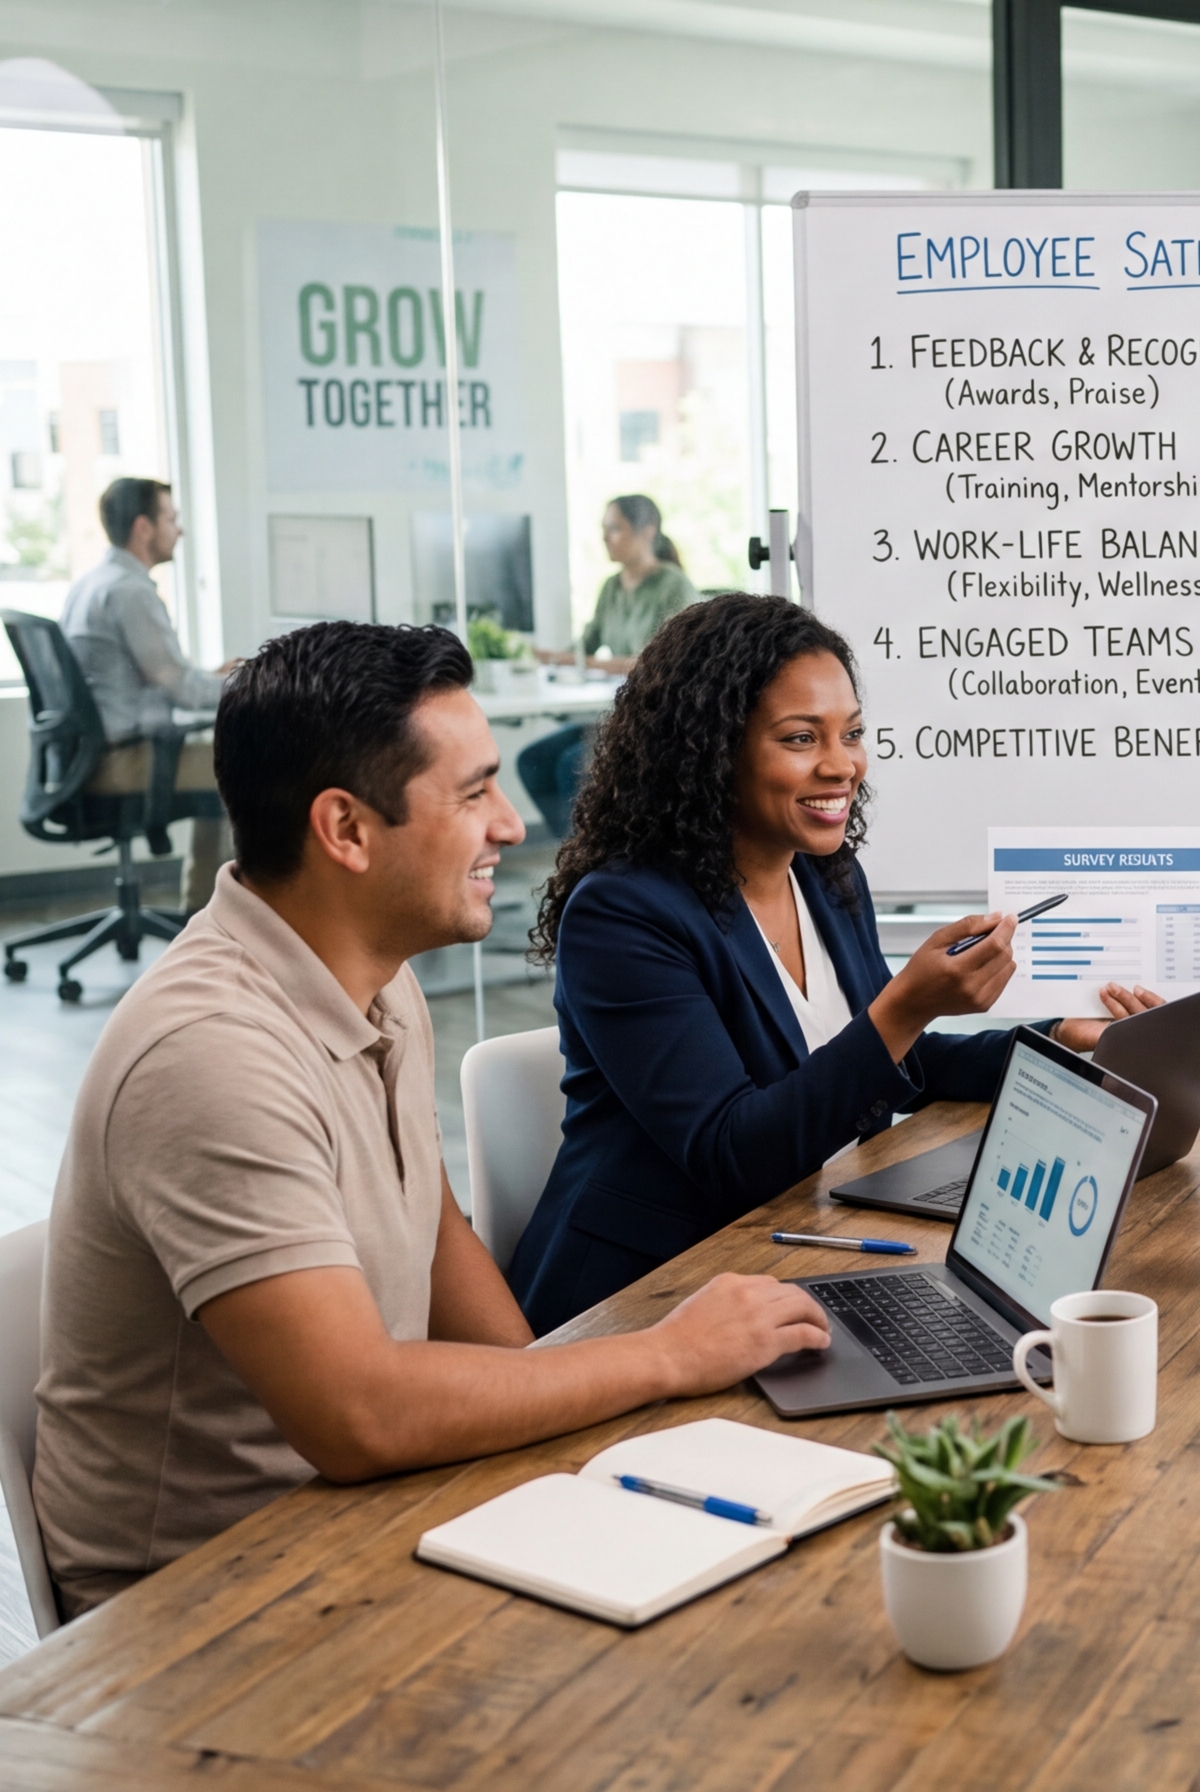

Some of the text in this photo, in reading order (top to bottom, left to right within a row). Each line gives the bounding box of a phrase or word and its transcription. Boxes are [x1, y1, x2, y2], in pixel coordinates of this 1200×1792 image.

[897, 231, 1096, 281] EMPLOYEE
[298, 282, 484, 369] GROW
[870, 335, 894, 371] 1.
[910, 333, 1067, 370] FEEDBACK
[1078, 336, 1096, 367] &
[944, 373, 1160, 411] (Awards, Praise)
[869, 429, 1177, 465] 2. CAREER GROWTH
[945, 471, 1070, 511] (Training,
[872, 528, 900, 563] 3.
[913, 528, 1083, 562] WORK-LIFE
[947, 569, 1090, 609] (Flexibility,
[872, 624, 1194, 660] 4. ENGAGED TEAMS
[948, 667, 1128, 700] (Collaboration,
[876, 727, 904, 761] 5.
[915, 724, 1097, 760] COMPETITIVE
[1063, 853, 1115, 866] SURVEY
